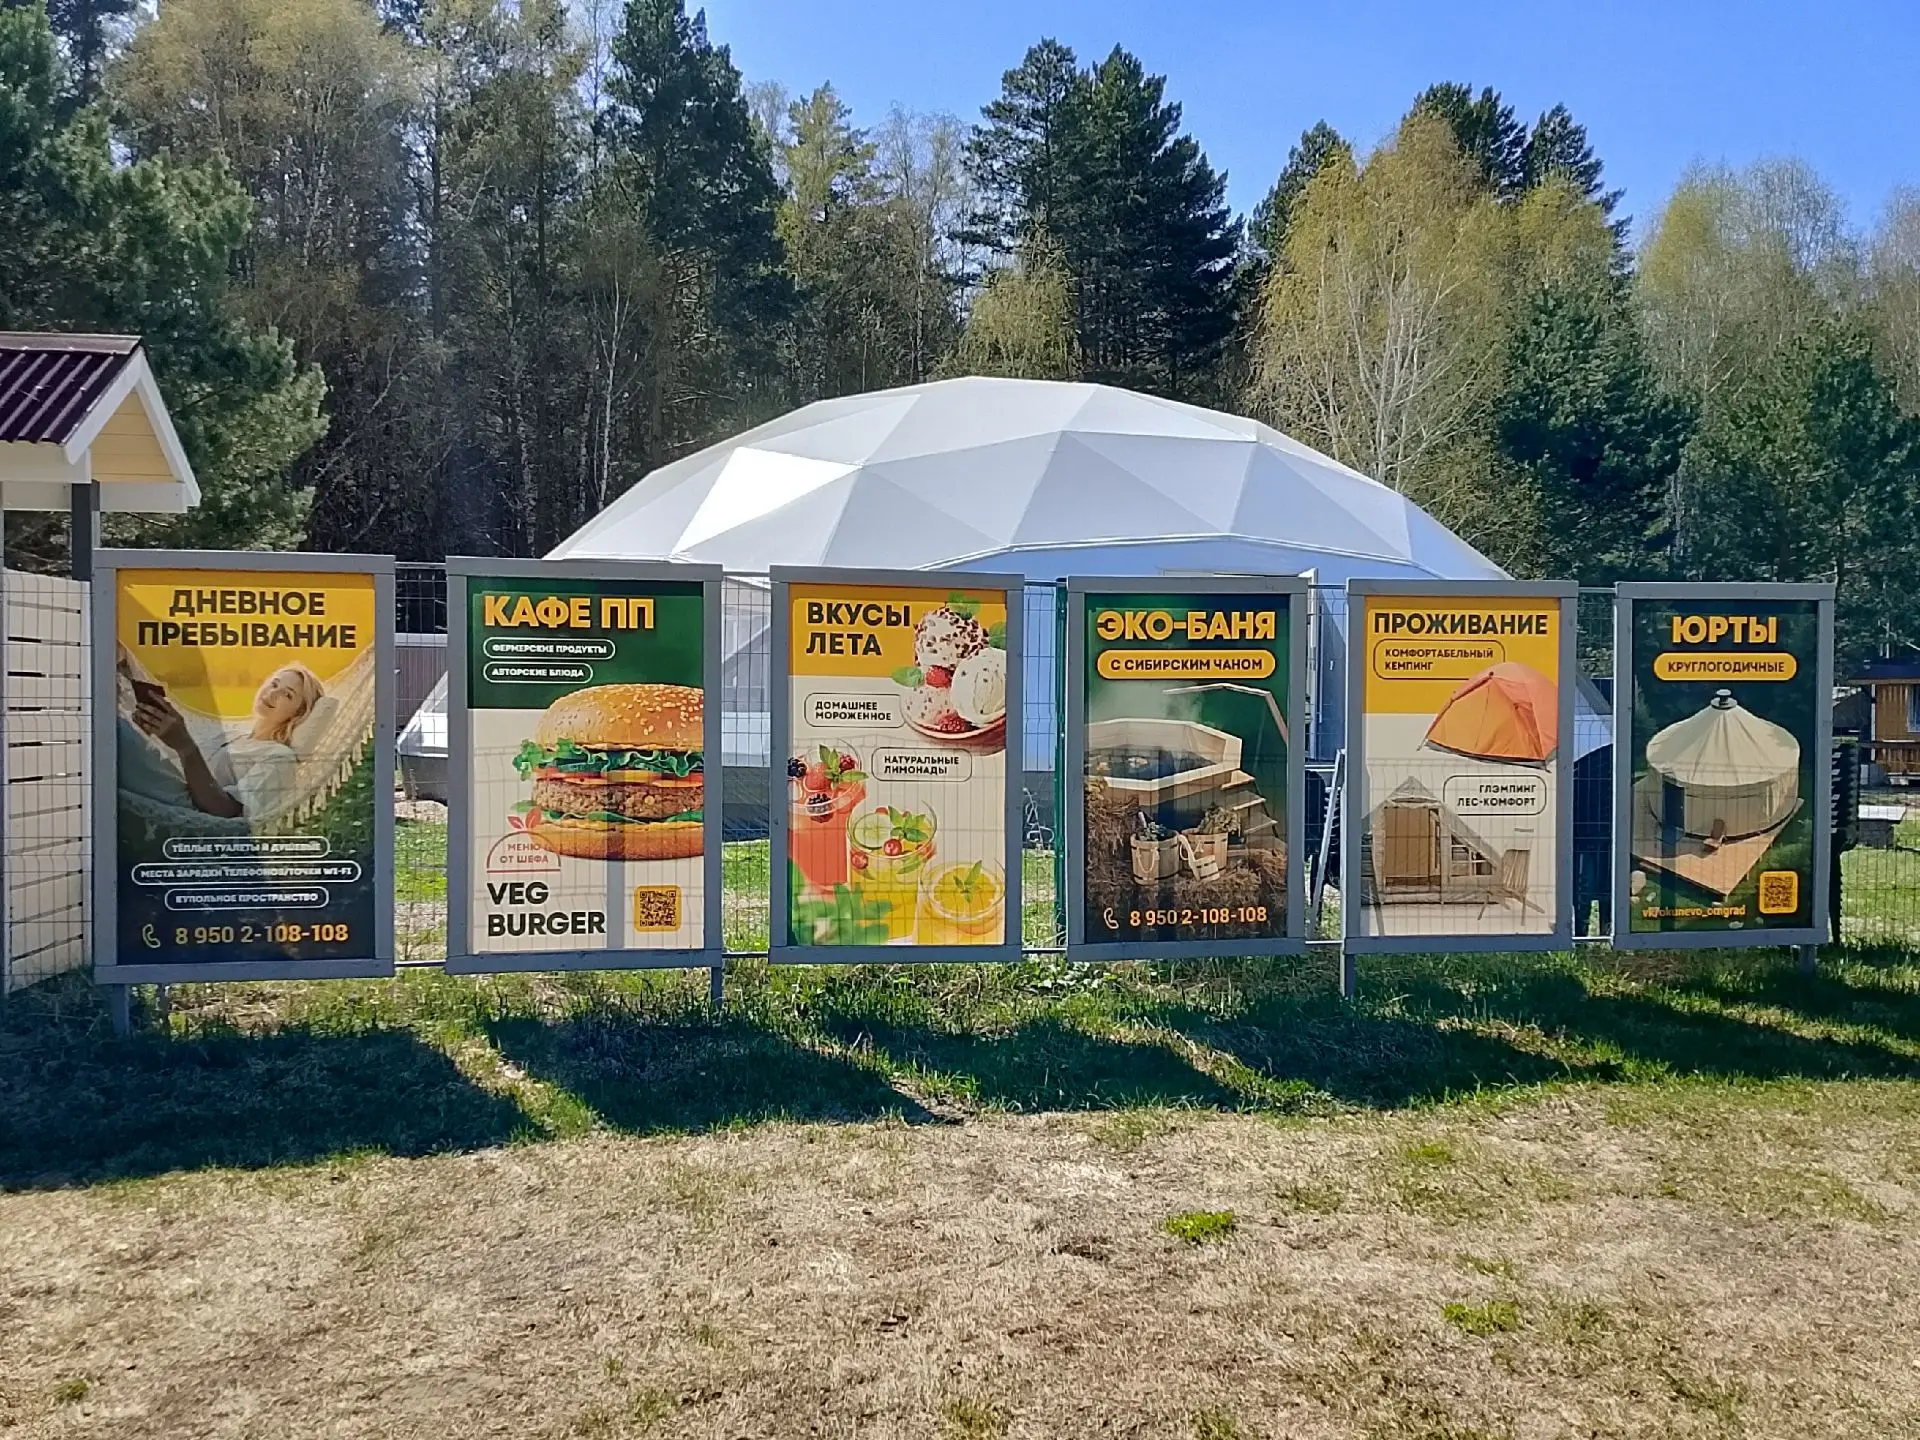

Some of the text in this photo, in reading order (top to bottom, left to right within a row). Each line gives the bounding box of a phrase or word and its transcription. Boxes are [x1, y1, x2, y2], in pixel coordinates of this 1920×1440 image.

[169, 589, 326, 617] ДНЕВНОЕ
[484, 595, 654, 629] КАФЕ ПП
[807, 601, 911, 627] ВКУСЫ
[1096, 610, 1276, 640] ЭКО-БАНЯ
[1374, 612, 1548, 635] ПРОЖИВАНИЕ
[1671, 615, 1777, 644] ЮРТЫ
[138, 621, 357, 648] ПРЕБЫВАНИЕ
[492, 644, 607, 654] ФЕРМЕРСКИЕ ПРОДУКТЫ
[805, 632, 883, 656] ЛЕТА
[1385, 648, 1493, 658] КОМФОРТАБЕЛЬНЫЙ
[1110, 658, 1263, 670] С СИБИРСКИМ ЧАНОМ
[1385, 661, 1433, 671] КЕМПИНГ
[1667, 661, 1785, 673] КРУГЛОГОДИЧНЫЕ
[491, 668, 584, 677] АВТОРСКИЕ БЛЮДА
[815, 701, 878, 711] ДОМАШНЕЕ
[815, 711, 892, 721] МОРОЖЕННОЕ
[884, 755, 959, 765] НАТУРАЛЬНЫЕ
[884, 765, 947, 775] ЛИМОНАДЫ
[1479, 784, 1536, 793] ГЛЭМПИНГ
[1457, 797, 1536, 807] ЛЕС-КОМФОРТ
[214, 843, 260, 853] ТУАЛЕТЫ
[507, 843, 541, 851] МЕНЮ
[500, 854, 548, 863] ОТ ШЕФА
[140, 869, 175, 879] МЕСТА
[323, 867, 352, 876] WI-FI
[238, 892, 319, 903] ПРОСТРАНСТВО
[487, 881, 549, 905] VEG
[1130, 906, 1267, 926] 8 950 2-108-108
[488, 911, 606, 937] BURGER
[175, 924, 349, 944] 8 950 2-108-108
